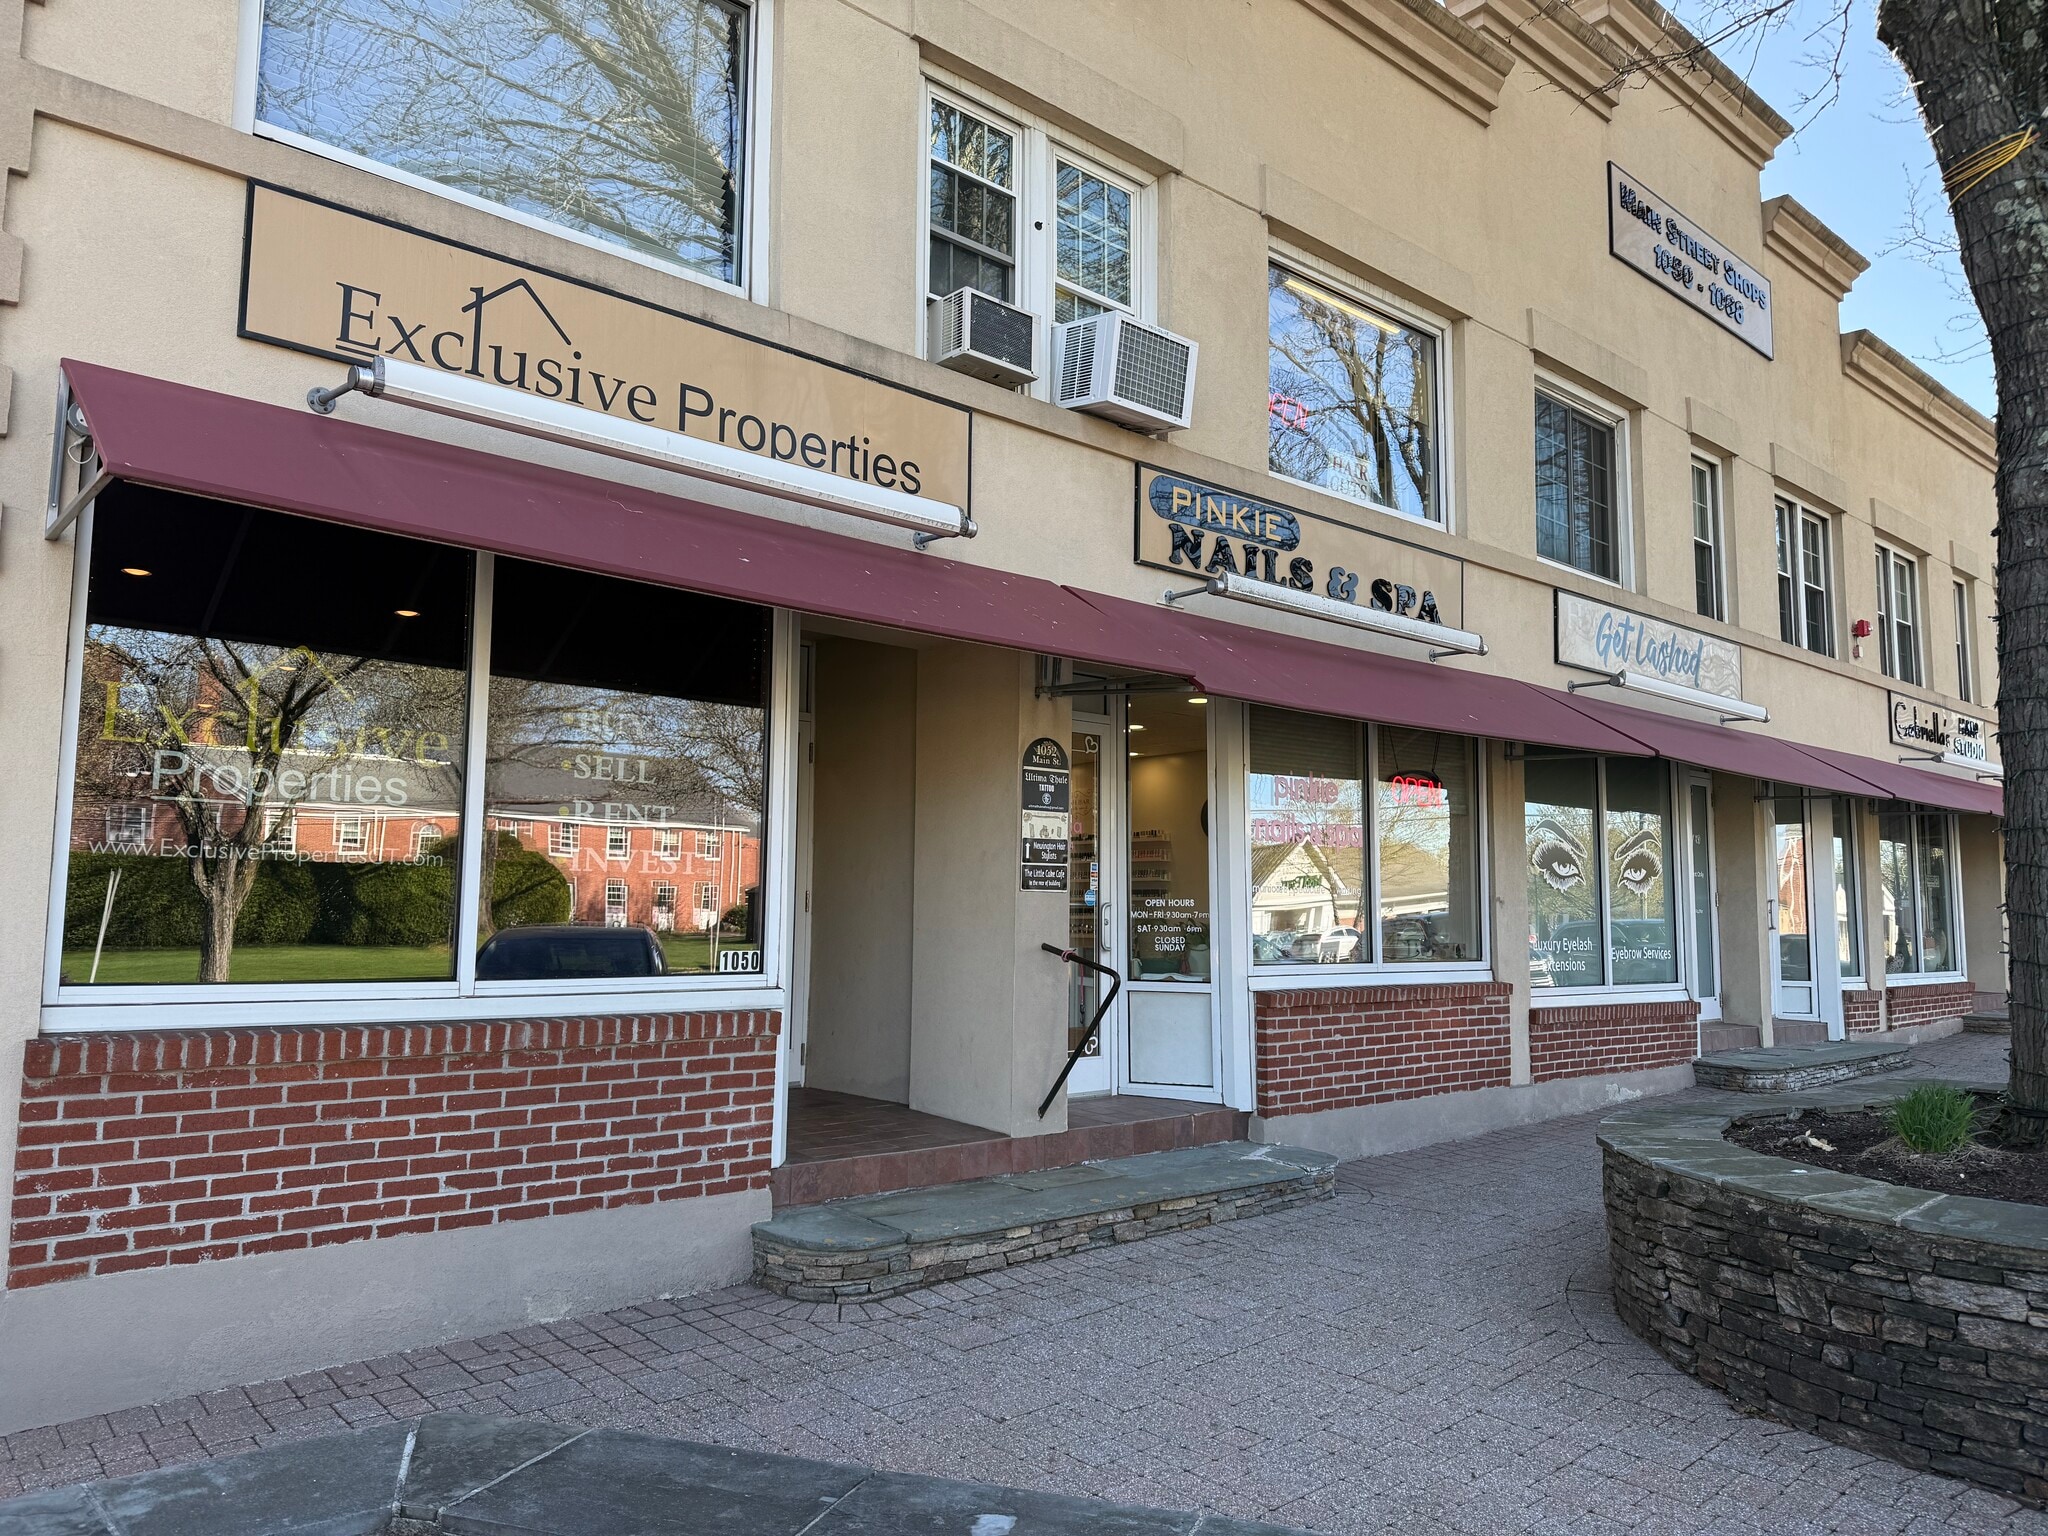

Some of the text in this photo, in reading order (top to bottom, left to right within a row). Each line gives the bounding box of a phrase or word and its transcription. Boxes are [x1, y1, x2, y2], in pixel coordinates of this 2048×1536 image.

[336, 278, 922, 496] Exclusive Properties
[1269, 392, 1309, 430] PEN
[1333, 456, 1369, 482] HAIR
[1330, 475, 1368, 500] CUTS
[1172, 486, 1284, 543] PINKIE
[1168, 522, 1443, 626] NAILS & SPA
[1595, 611, 1704, 689] Get Lashed
[1032, 755, 1051, 765] Main
[1036, 744, 1058, 757] 1052
[151, 749, 410, 807] Properties
[573, 754, 658, 785] SELL
[1274, 770, 1339, 806] pinkie
[1391, 775, 1442, 808] OPEN
[572, 799, 676, 829] RENT
[1254, 813, 1306, 844] nails
[568, 847, 697, 876] INVEST
[1033, 869, 1045, 878] Little
[1144, 898, 1195, 908] OPEN HOURS
[1154, 936, 1186, 944] CLOSED
[1154, 944, 1186, 952] SUNDAY
[1533, 936, 1593, 954] Luxury Eyelash
[1612, 945, 1672, 962] Eyebrow Services
[721, 950, 759, 972] 1050
